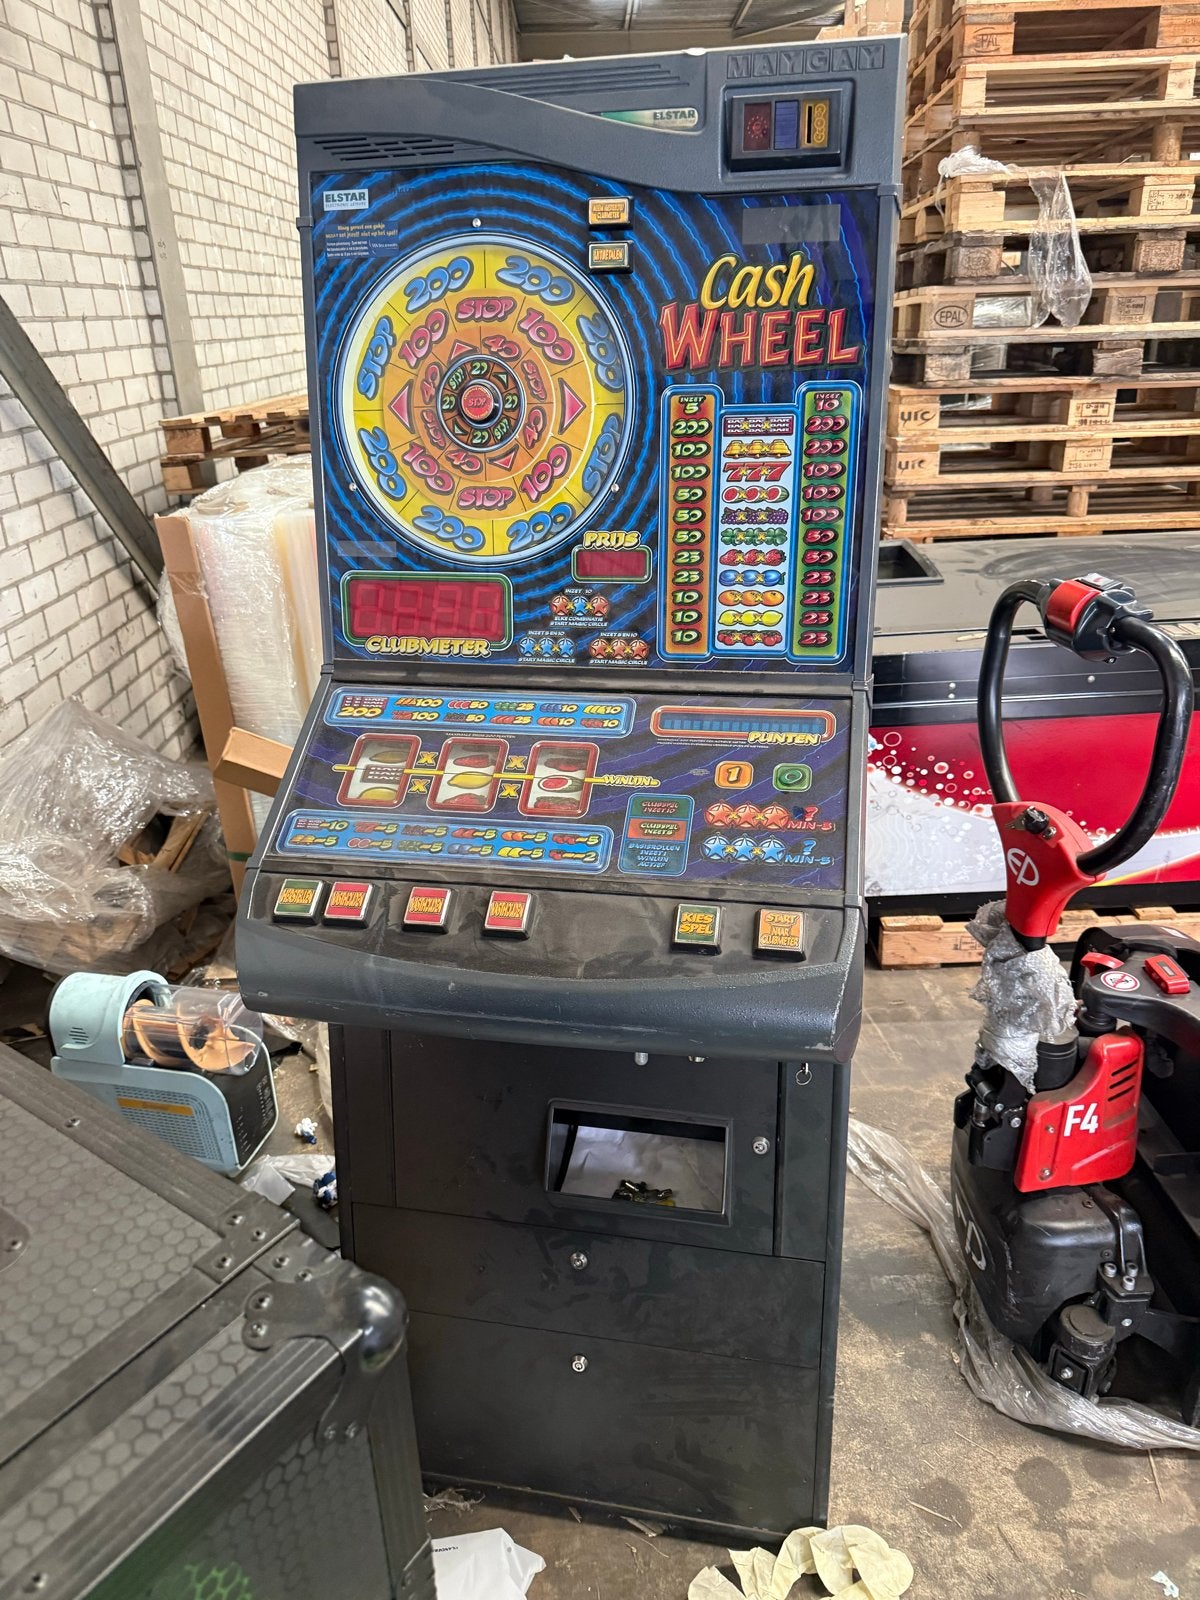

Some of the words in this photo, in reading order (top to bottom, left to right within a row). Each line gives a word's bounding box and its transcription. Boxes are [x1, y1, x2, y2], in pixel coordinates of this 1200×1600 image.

[728, 46, 882, 78] MAYGAY
[653, 109, 695, 120] ELSTAR
[325, 191, 366, 203] ELSTAR
[404, 257, 474, 314] 200
[496, 255, 574, 306] 200
[701, 254, 815, 310] Cash
[456, 298, 516, 321] STOP
[938, 310, 962, 324] EPAL
[399, 309, 448, 368] 100
[518, 307, 574, 363] 100
[660, 302, 859, 369] WHEEL
[358, 316, 396, 399] STOP
[577, 314, 623, 391] 200
[684, 402, 699, 414] 5
[816, 399, 840, 411] 10
[583, 414, 622, 498] STOP
[359, 428, 406, 501] 200
[403, 443, 454, 494] 100
[520, 445, 570, 502] 100
[457, 487, 515, 510] STOP
[413, 506, 484, 550] 200
[507, 503, 574, 551] 200
[584, 532, 640, 549] PRIJS
[366, 636, 490, 657] CLUBMETER
[415, 698, 443, 708] 100
[469, 700, 489, 710] 50
[516, 702, 536, 712] 25
[560, 704, 578, 713] 10
[605, 705, 622, 714] 10
[337, 707, 382, 718] 200
[412, 712, 439, 720] 100
[466, 713, 486, 722] 50
[513, 716, 532, 724] 25
[558, 718, 575, 726] 10
[602, 719, 620, 728] 10
[749, 732, 821, 746] PUNTEN
[604, 774, 653, 786] WINLIJN
[727, 766, 741, 782] 1
[682, 912, 714, 924] KIES
[766, 914, 798, 924] START
[678, 924, 713, 934] SPEL
[760, 936, 800, 948] CLUBMETER
[1064, 1102, 1099, 1138] F4
